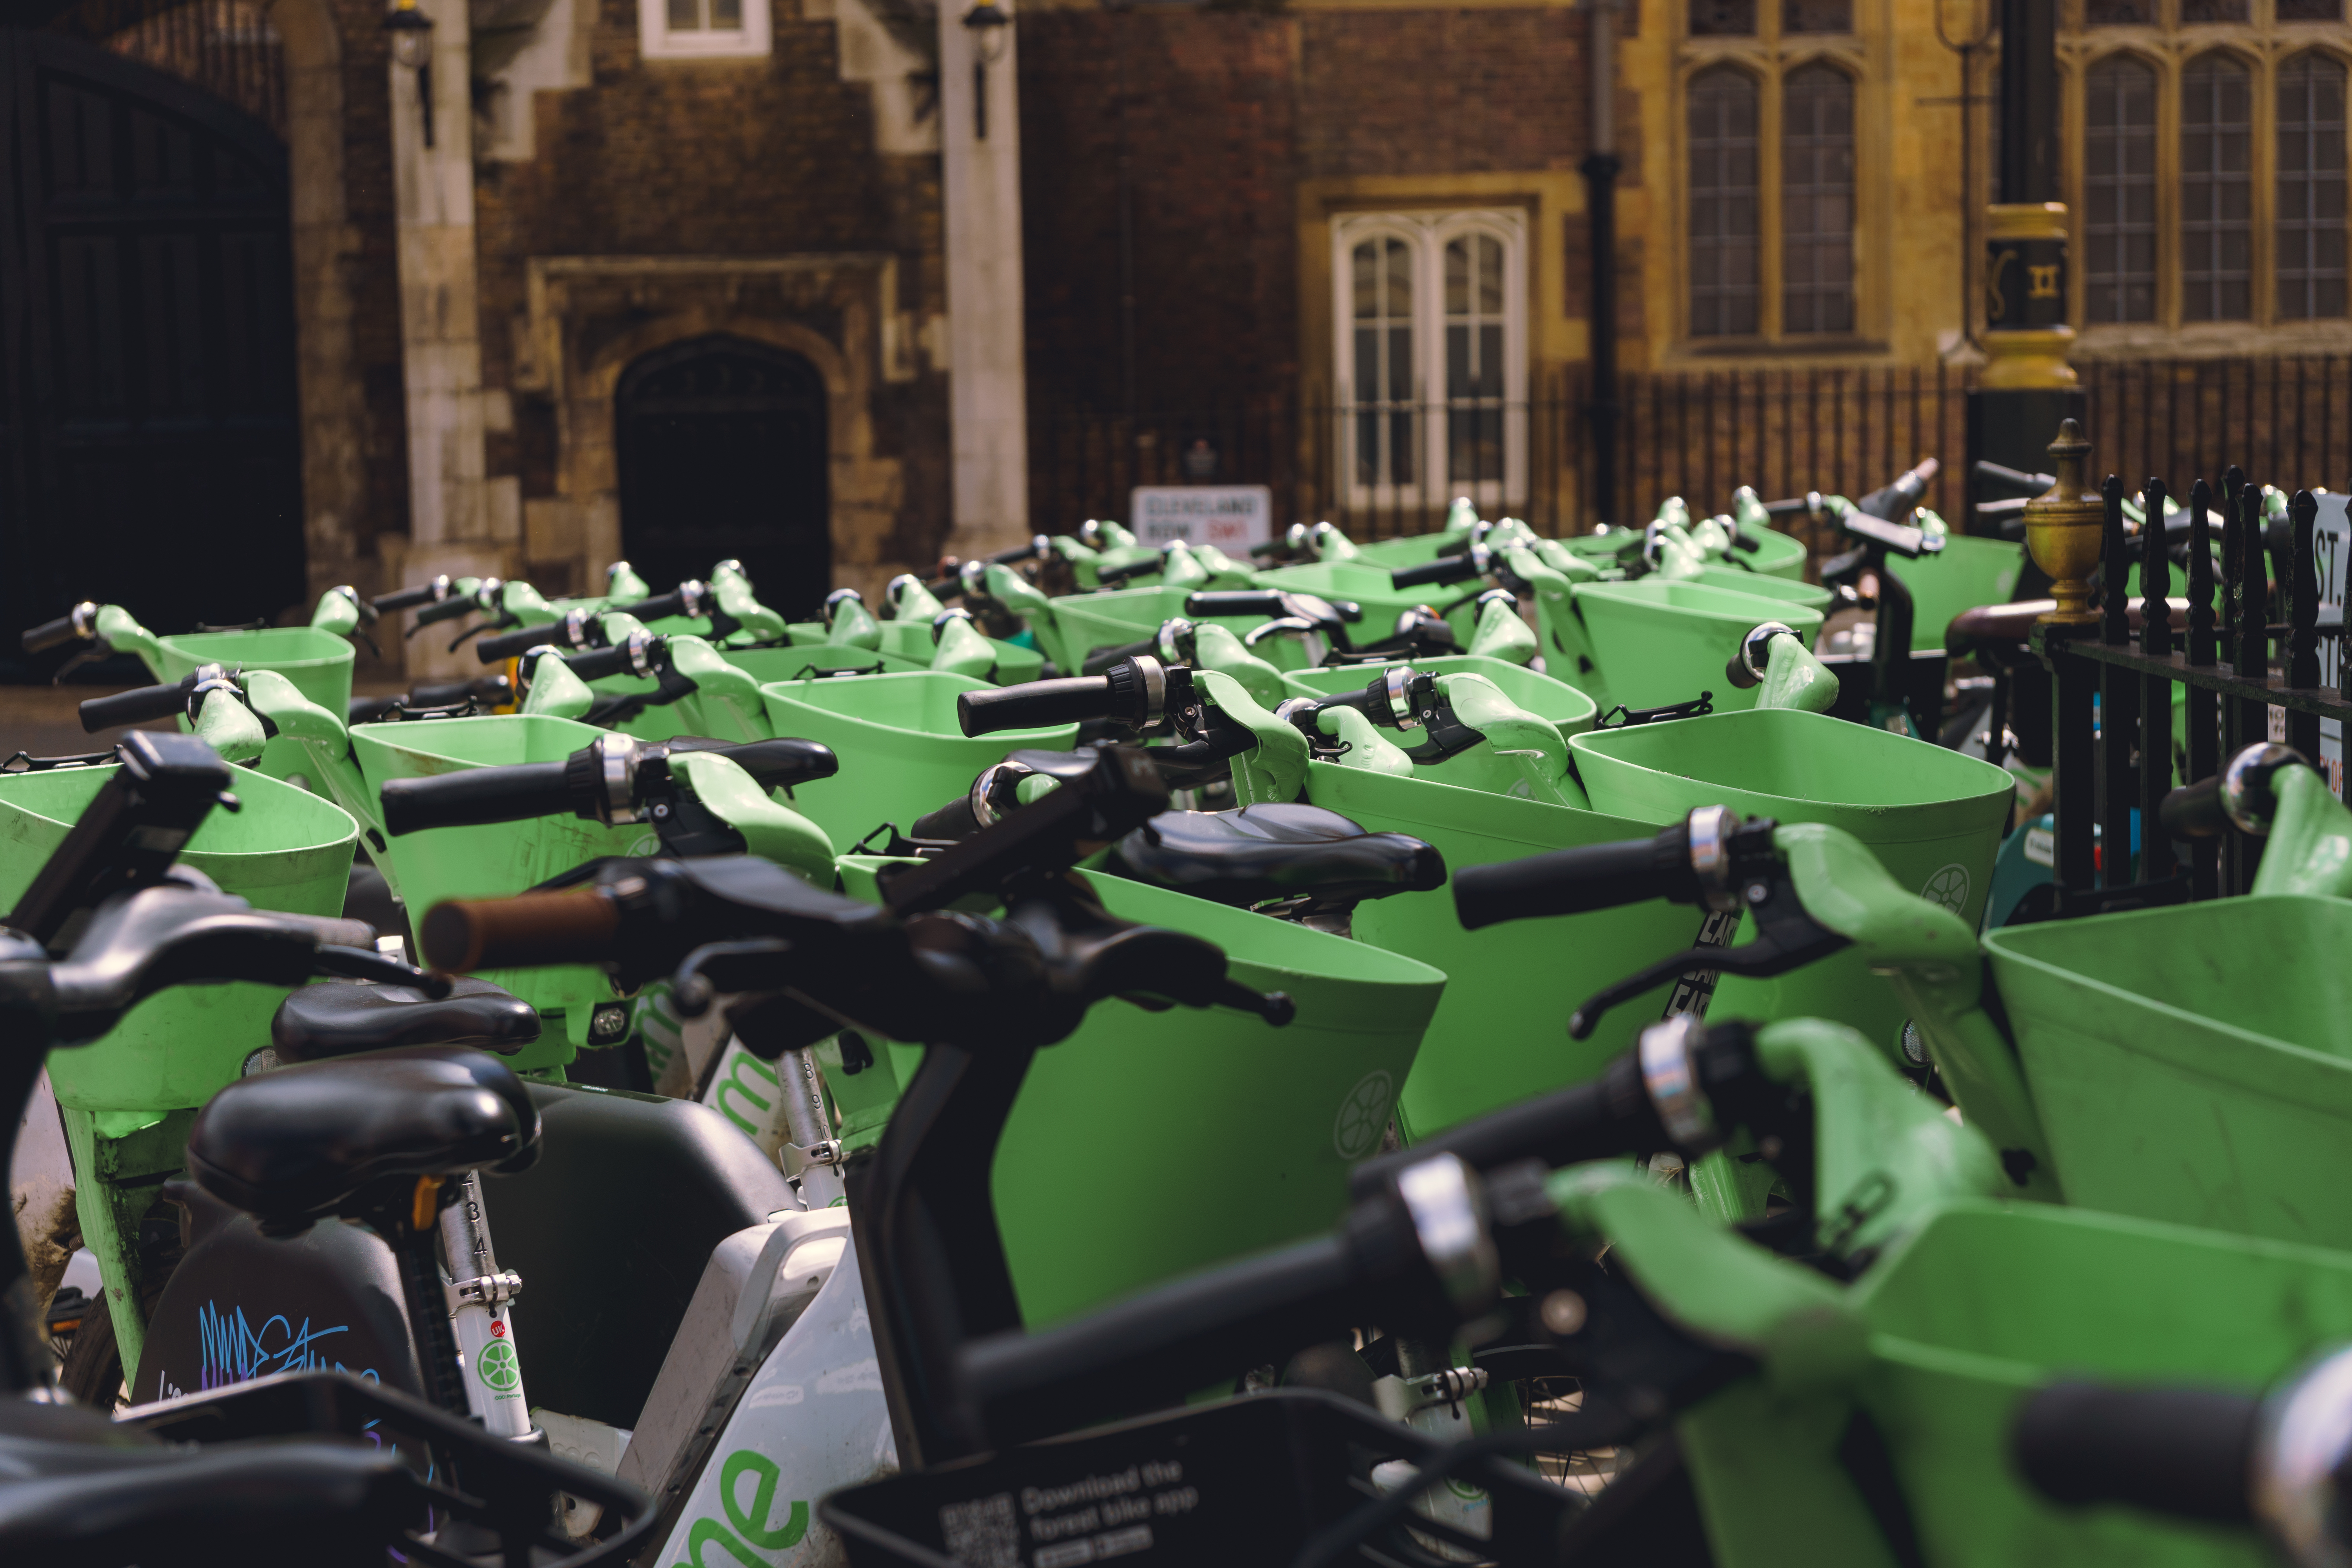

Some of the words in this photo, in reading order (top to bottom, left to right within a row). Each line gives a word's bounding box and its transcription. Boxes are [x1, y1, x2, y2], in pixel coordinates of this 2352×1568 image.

[804, 1063, 813, 1079] 8
[812, 1094, 821, 1109] 9
[466, 1201, 480, 1221] 3
[474, 1236, 487, 1255] 4
[492, 1324, 505, 1336] UK
[1022, 1464, 1140, 1515] Download
[1141, 1459, 1183, 1487] the
[1101, 1495, 1151, 1526] bike
[1154, 1486, 1199, 1516] app
